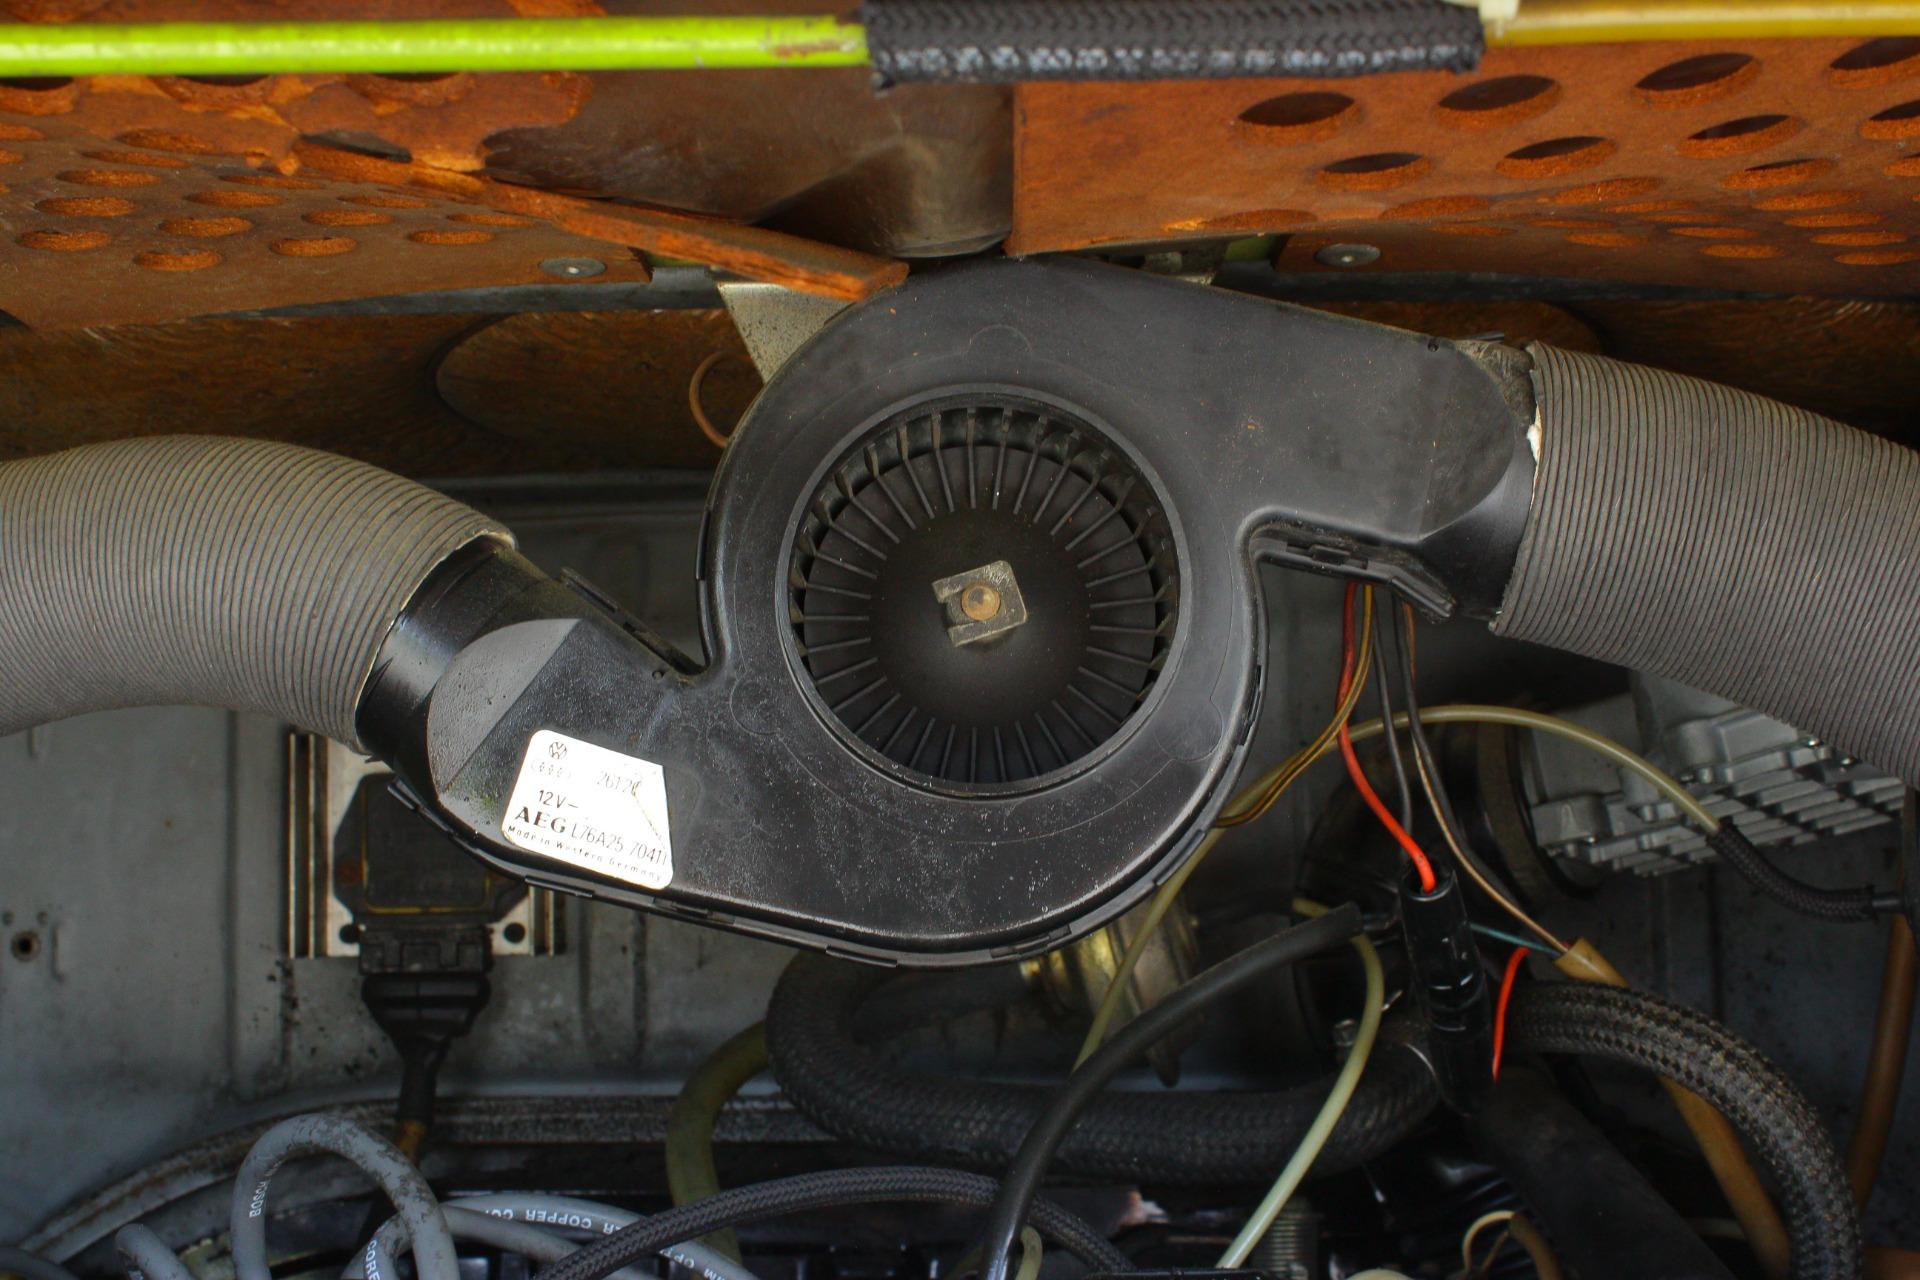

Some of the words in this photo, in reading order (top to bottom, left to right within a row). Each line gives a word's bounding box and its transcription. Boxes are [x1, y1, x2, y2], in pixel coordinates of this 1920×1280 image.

[514, 806, 566, 833] AEG
[507, 825, 537, 840] Made
[540, 836, 551, 846] in
[556, 841, 603, 862] Western
[609, 857, 662, 882] Germany
[525, 1209, 592, 1229] COPPER
